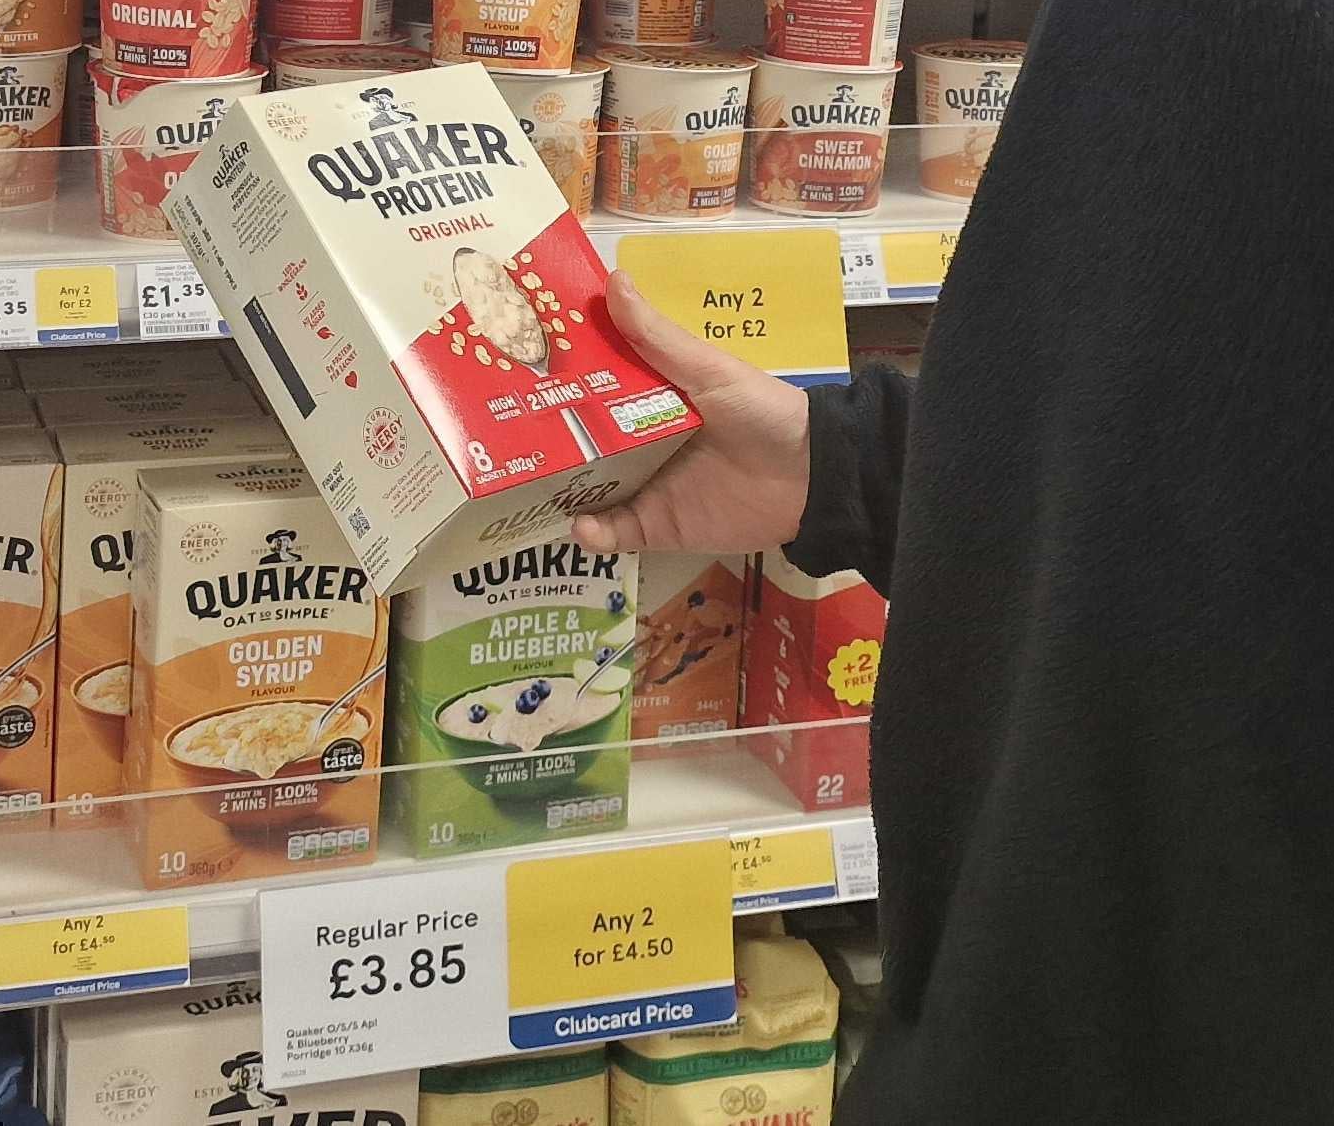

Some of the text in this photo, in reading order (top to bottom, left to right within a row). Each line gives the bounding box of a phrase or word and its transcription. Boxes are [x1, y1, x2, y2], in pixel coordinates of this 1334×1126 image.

[112, 3, 197, 28] ORIGINAL
[2, 32, 38, 42] BUTTER
[814, 138, 864, 155] SWEET
[307, 123, 518, 202] QUAKER
[798, 154, 872, 170] CINNAMON
[369, 172, 493, 218] PROTEIN
[408, 215, 493, 243] ORIGINAL
[703, 287, 764, 310] Any 2
[704, 318, 766, 339] for £2
[488, 612, 580, 638] APPLE &
[228, 634, 323, 664] GOLDEN
[470, 634, 598, 665] BLUEBERRY
[236, 660, 314, 688] SYRUP
[251, 685, 295, 696] FLAVOUR
[316, 909, 479, 951] Regular Price
[593, 907, 654, 937] Any 2
[574, 947, 605, 968] for
[329, 943, 466, 1001] £3.85
[554, 1001, 694, 1038] Clubcard Price
[286, 1027, 324, 1038] Quaker
[287, 1035, 349, 1050] & Blueberry
[287, 1050, 331, 1061] Porridge
[335, 1046, 346, 1055] 10
